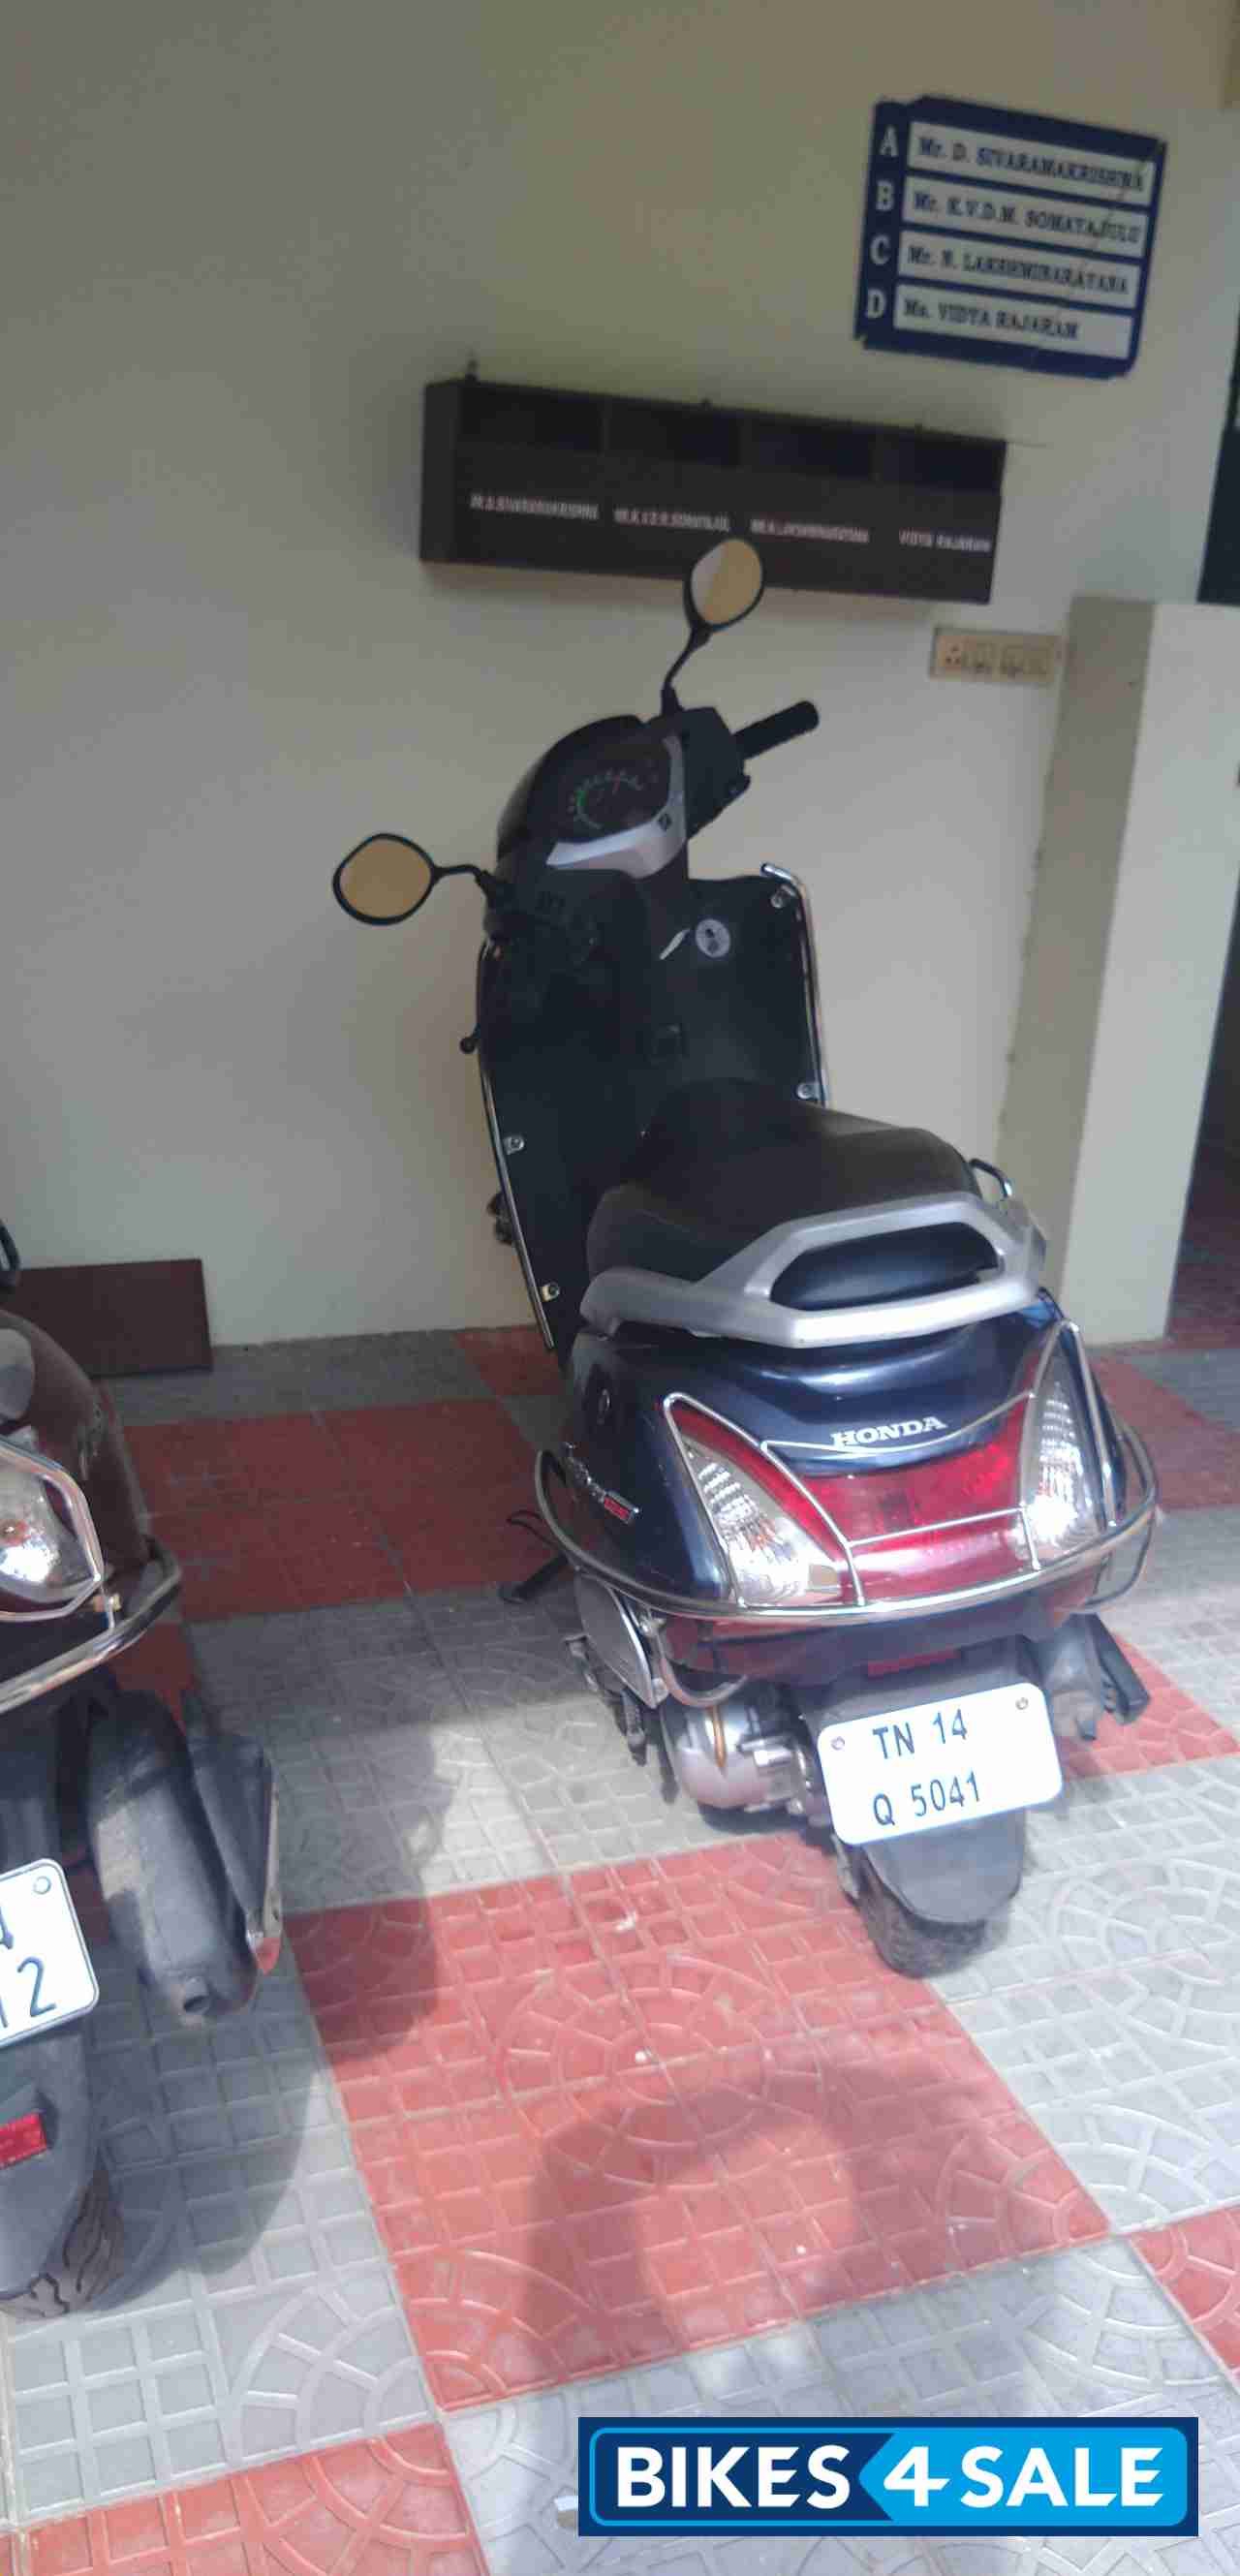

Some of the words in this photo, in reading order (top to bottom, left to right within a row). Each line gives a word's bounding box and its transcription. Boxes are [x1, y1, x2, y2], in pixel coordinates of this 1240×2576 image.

[880, 125, 898, 157] A
[919, 137, 946, 158] Mr.
[876, 180, 894, 211] B
[914, 191, 938, 212] Mr.
[871, 234, 890, 264] C
[865, 290, 885, 319] D
[830, 1416, 948, 1448] HONDA
[872, 1723, 914, 1759] TN
[933, 1709, 968, 1744] 14
[873, 1793, 895, 1825] Q
[911, 1771, 980, 1816] 5041
